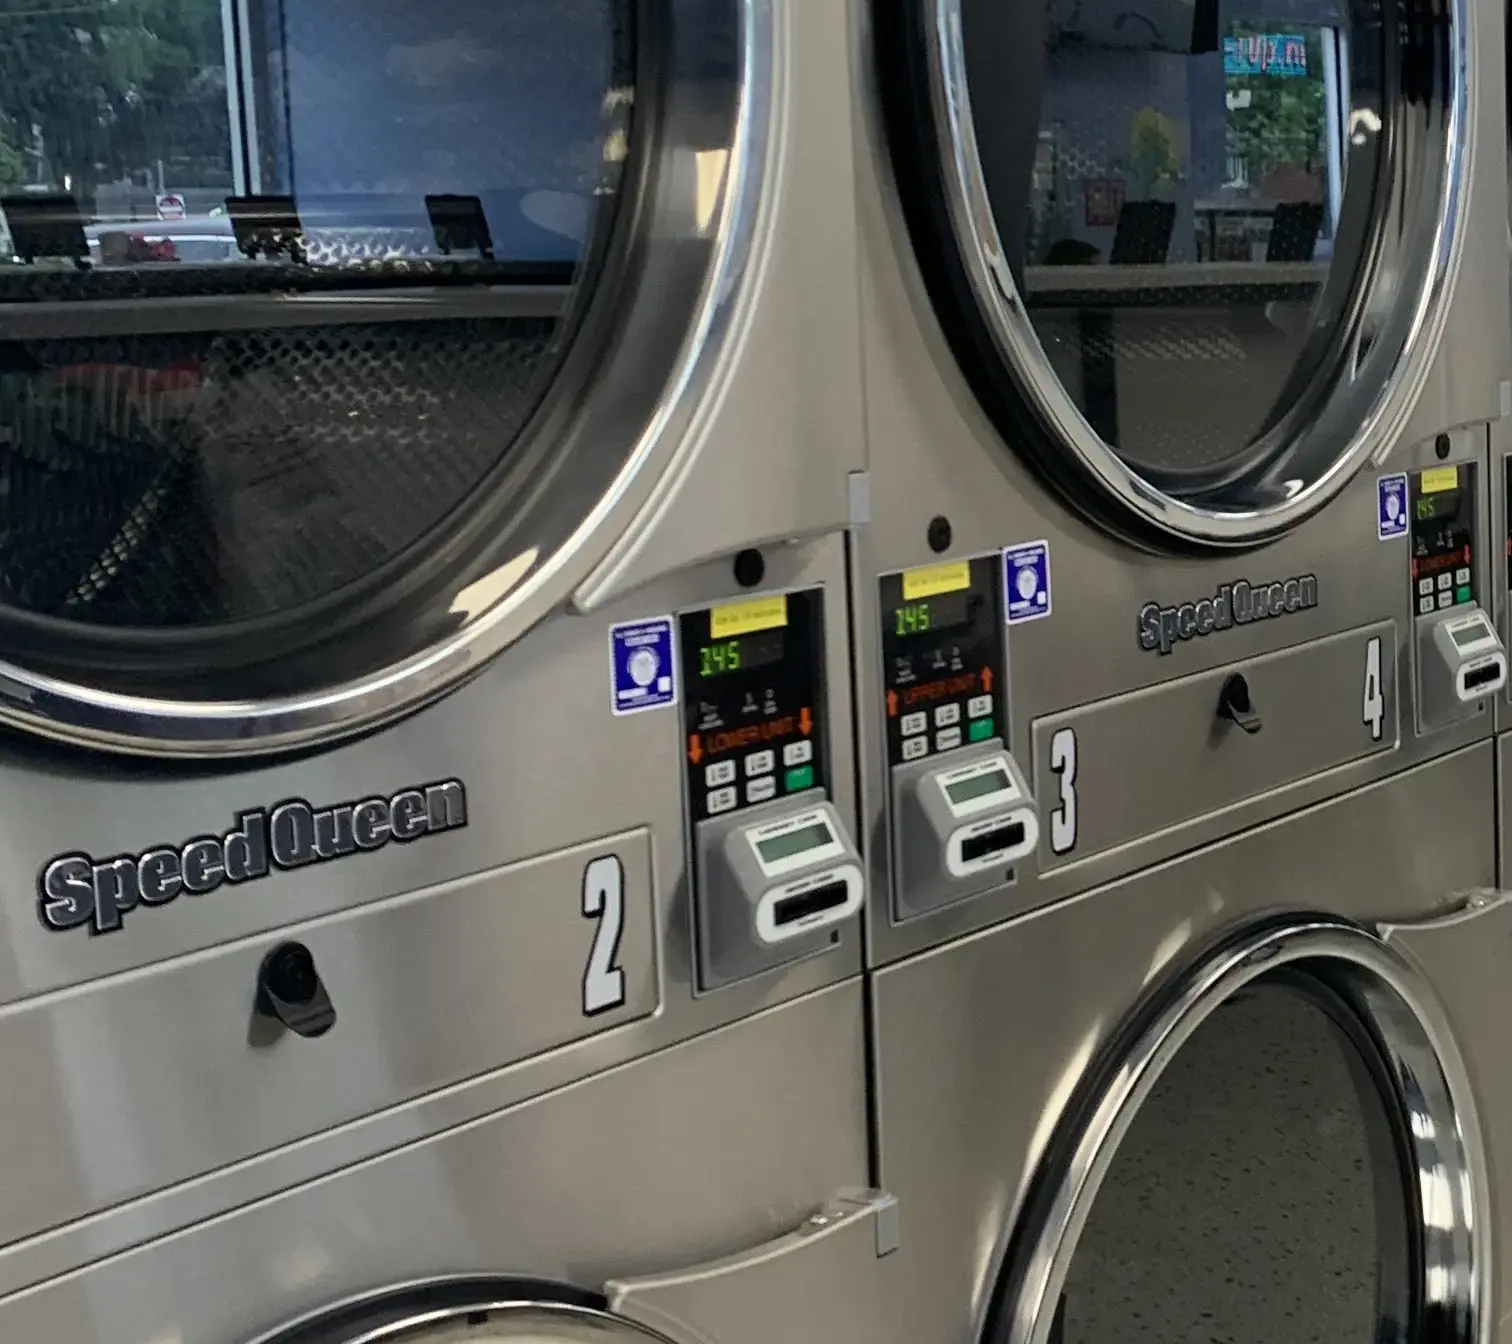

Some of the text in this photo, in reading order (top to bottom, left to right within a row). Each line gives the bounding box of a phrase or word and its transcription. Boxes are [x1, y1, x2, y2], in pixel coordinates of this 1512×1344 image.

[1363, 637, 1384, 741] 4
[1051, 727, 1077, 855] 3
[581, 854, 625, 1017] 2
